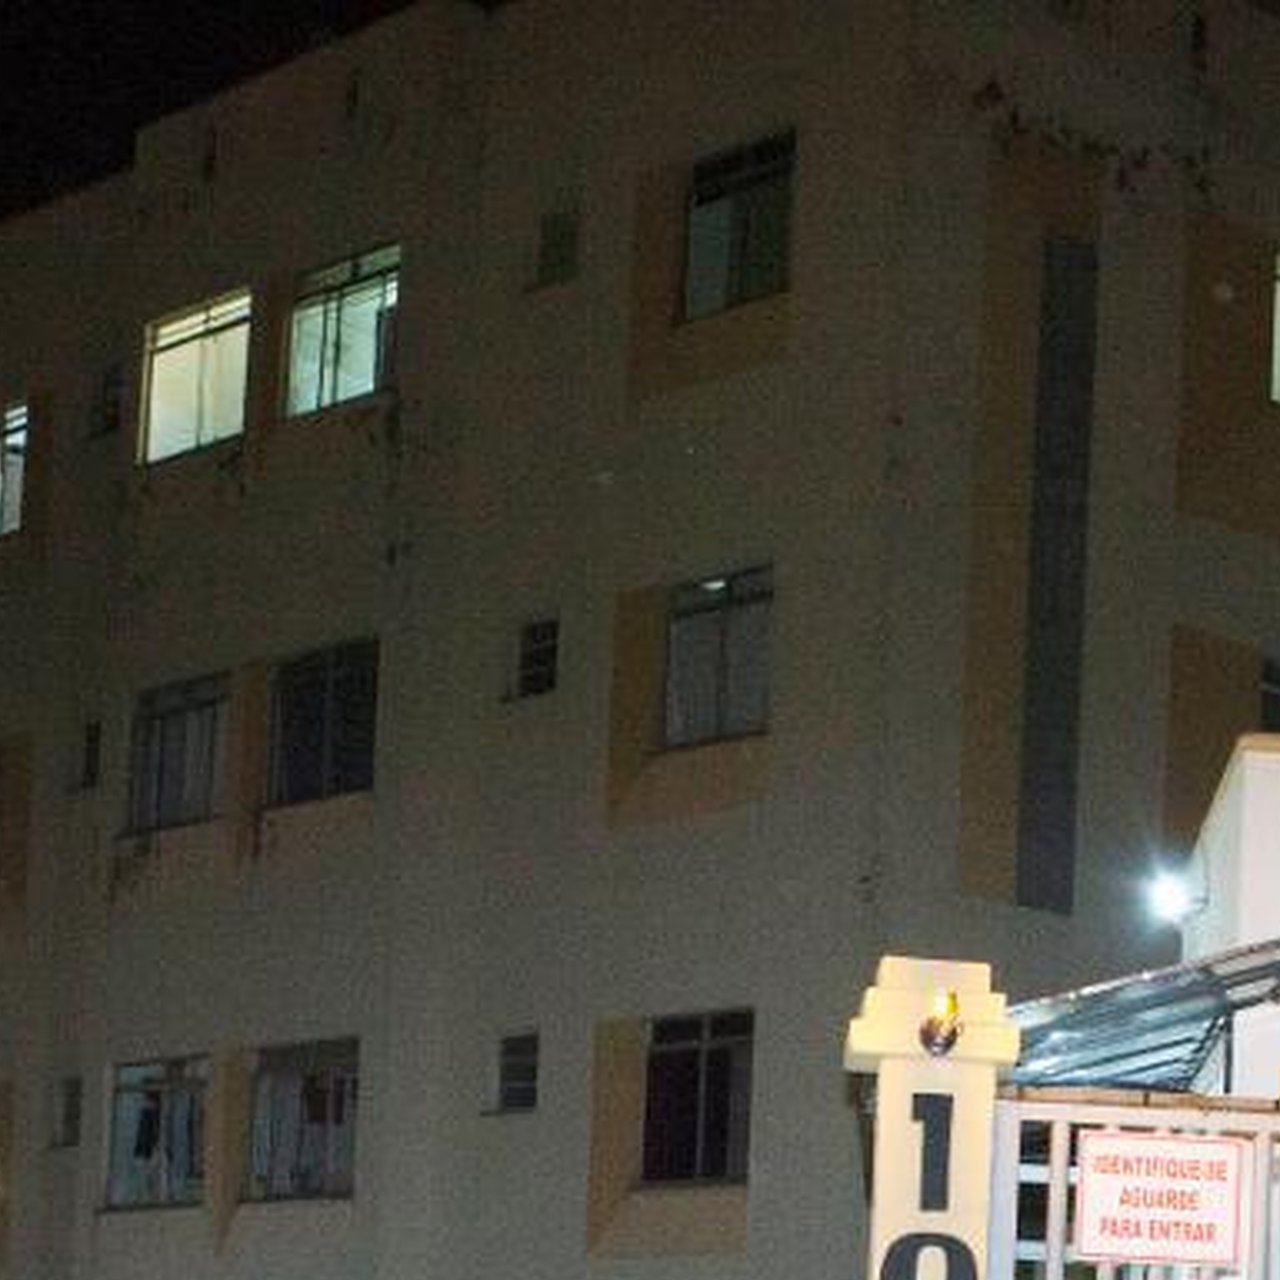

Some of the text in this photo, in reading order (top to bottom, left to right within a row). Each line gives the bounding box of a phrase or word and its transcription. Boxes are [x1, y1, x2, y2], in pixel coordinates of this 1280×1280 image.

[1120, 1187, 1200, 1211] AGUARDE
[1100, 1217, 1219, 1242] PARA ENTRAR
